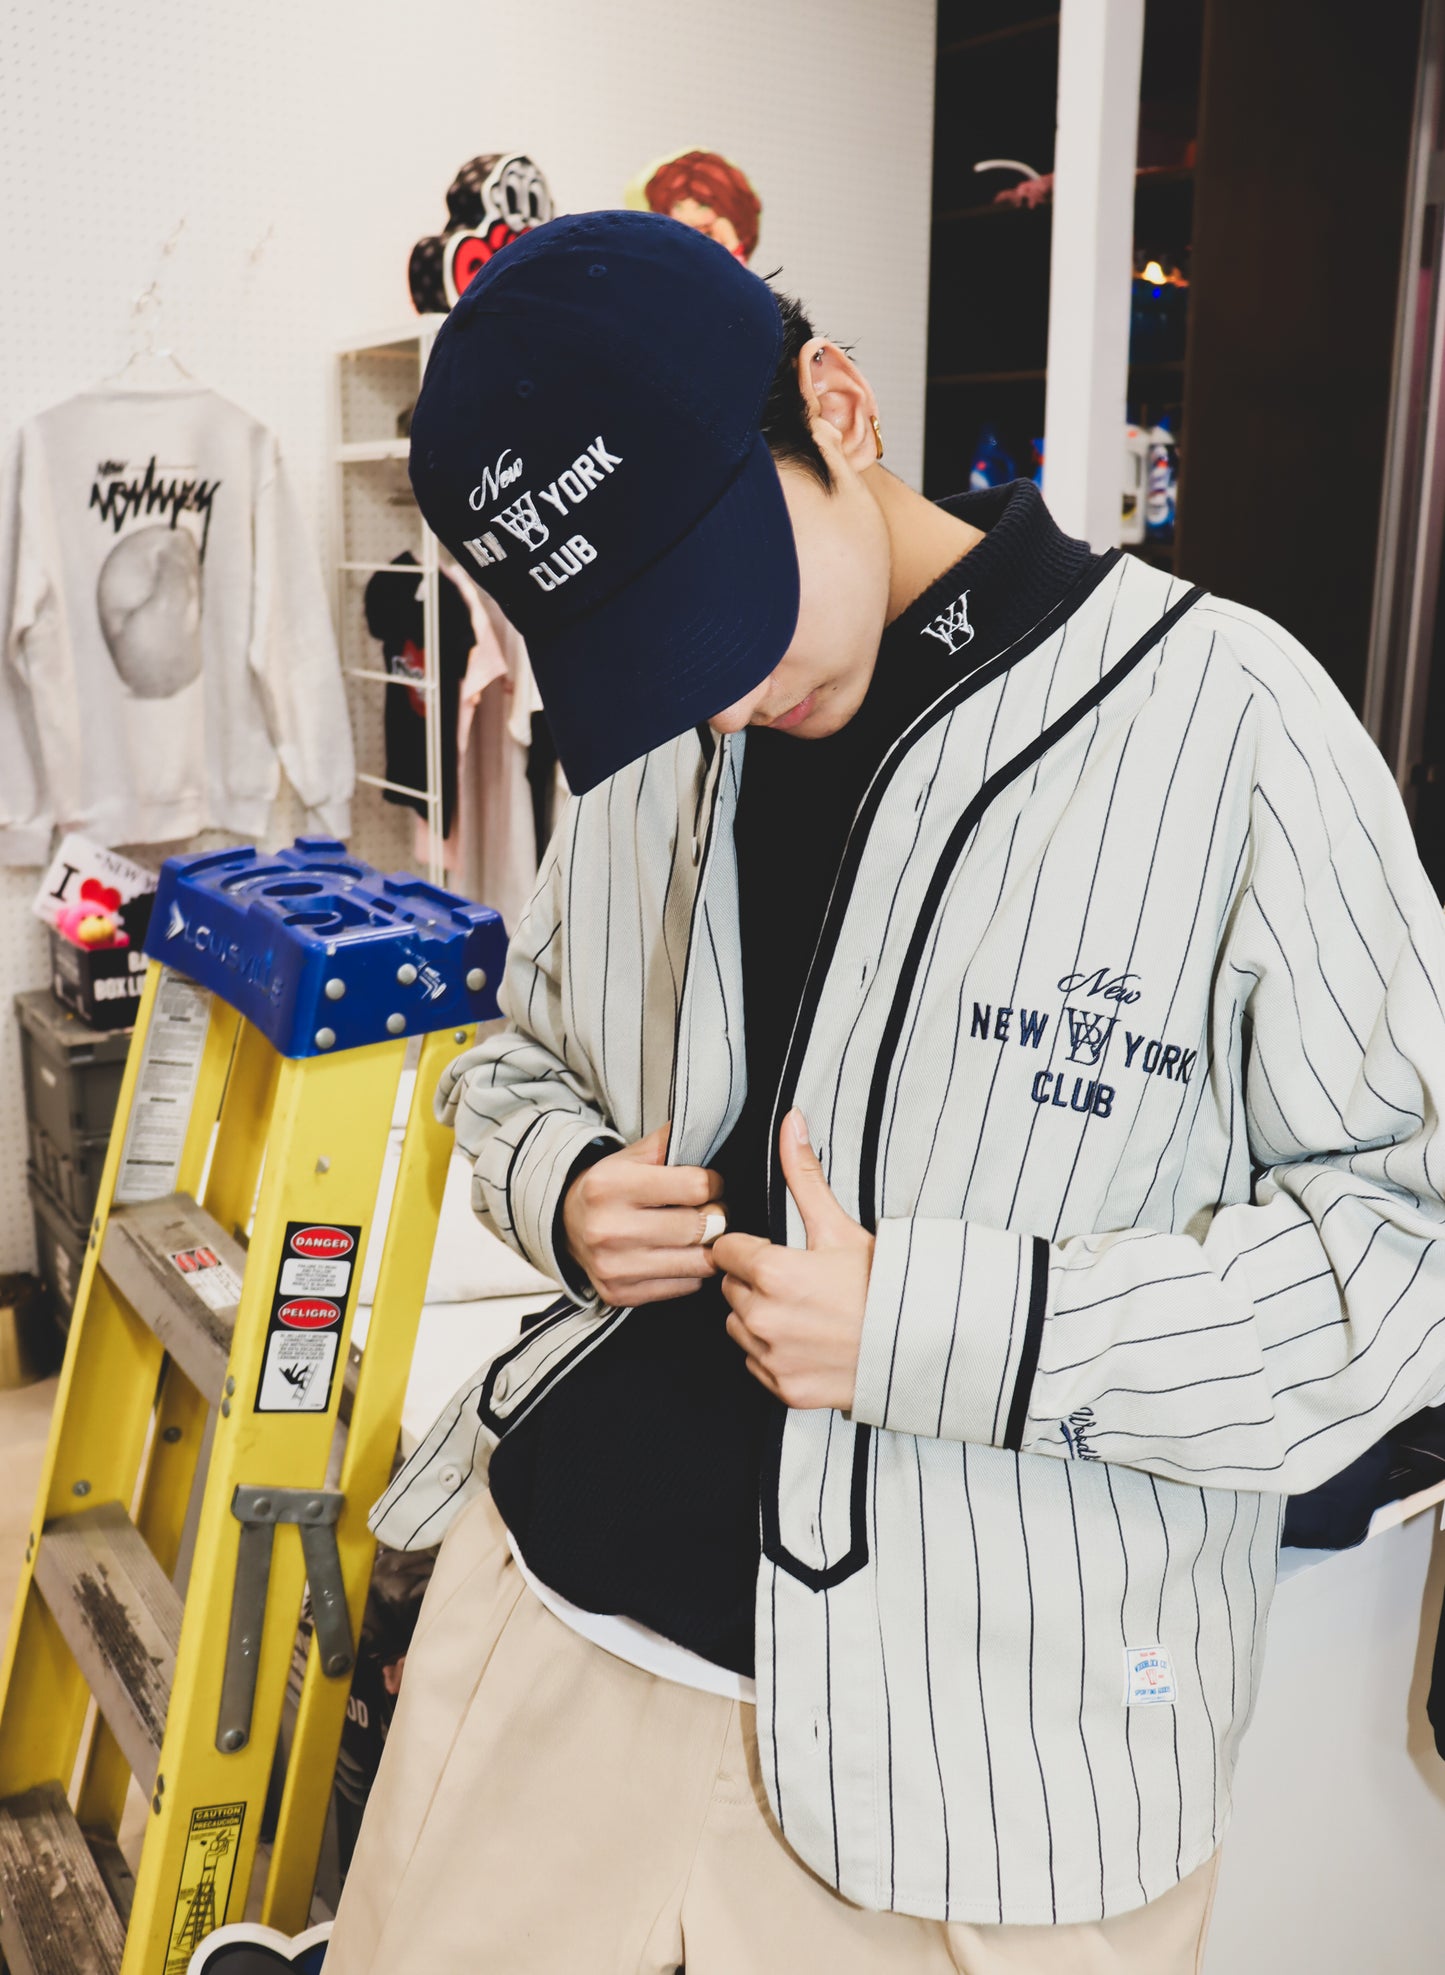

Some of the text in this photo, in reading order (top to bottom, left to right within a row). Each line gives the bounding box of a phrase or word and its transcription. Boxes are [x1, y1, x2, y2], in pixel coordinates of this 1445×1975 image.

[469, 449, 523, 511] New
[538, 435, 623, 516] YORK
[528, 534, 598, 591] CLUB
[1057, 967, 1141, 1005] New
[970, 1002, 1049, 1049] NEW
[1124, 1031, 1197, 1084] YORK
[1031, 1070, 1116, 1118] CLUB
[295, 1237, 349, 1248] DANGER
[282, 1308, 337, 1318] PELIGRO
[196, 1807, 241, 1819] CAUTION
